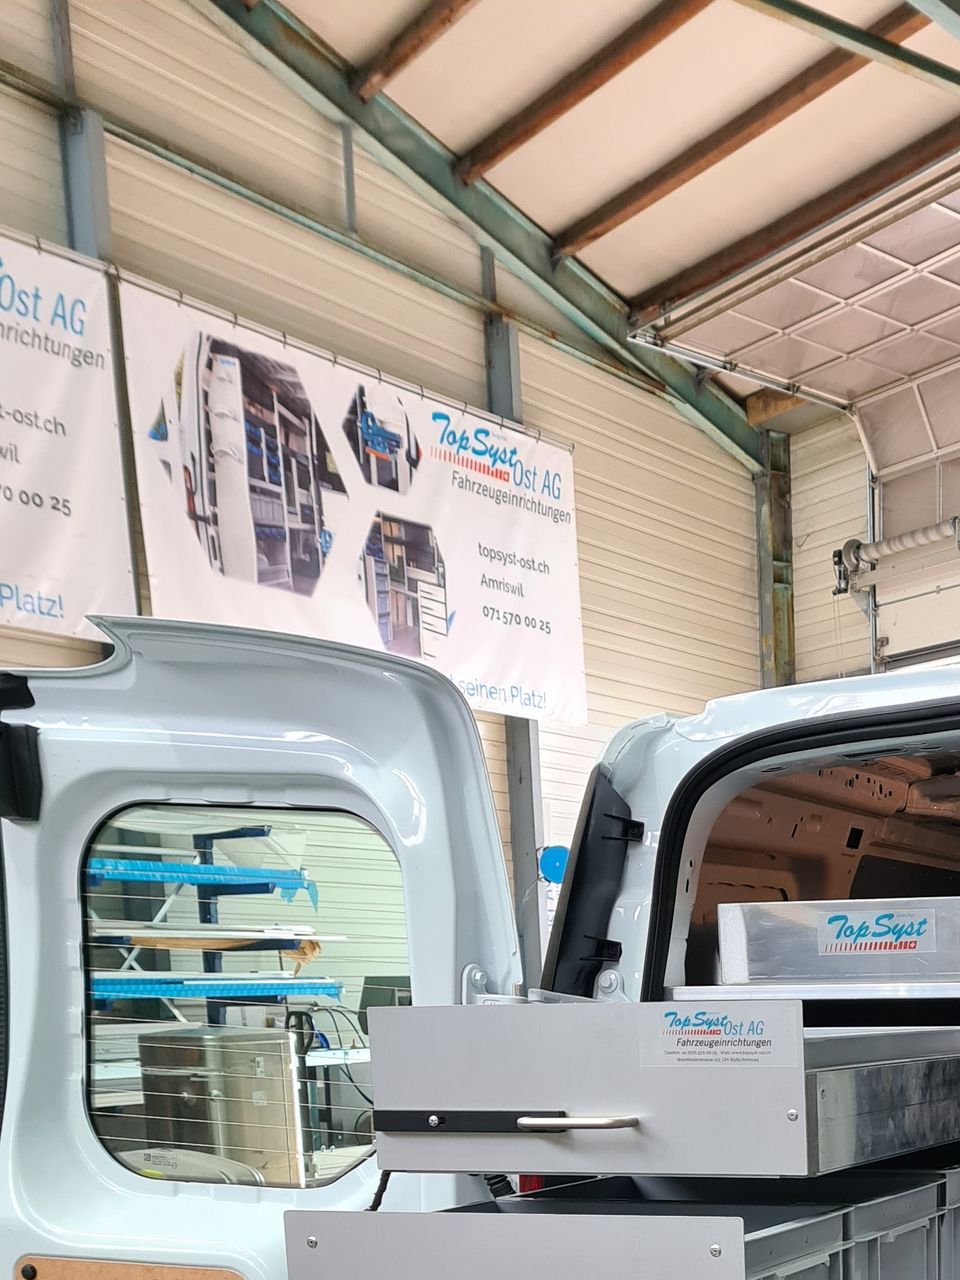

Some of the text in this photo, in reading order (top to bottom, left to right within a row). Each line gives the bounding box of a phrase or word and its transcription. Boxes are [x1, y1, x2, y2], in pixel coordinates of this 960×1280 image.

[50, 292, 87, 336] AG
[513, 459, 538, 493] Ost
[541, 470, 562, 501] AG
[19, 490, 44, 509] 00
[50, 496, 72, 517] 25
[451, 470, 572, 524] Fahrzeugeinrichtungen
[477, 542, 551, 575] topsyst-ost.ch
[0, 583, 64, 619] Platz!
[480, 573, 525, 598] Amriswil
[482, 605, 552, 635] 071 570 00 25
[458, 678, 546, 709] seinen Platz!
[676, 1037, 772, 1048] Fahrzeugeinrichtungen
[724, 1020, 744, 1036] Ost
[747, 1020, 765, 1036] AG
